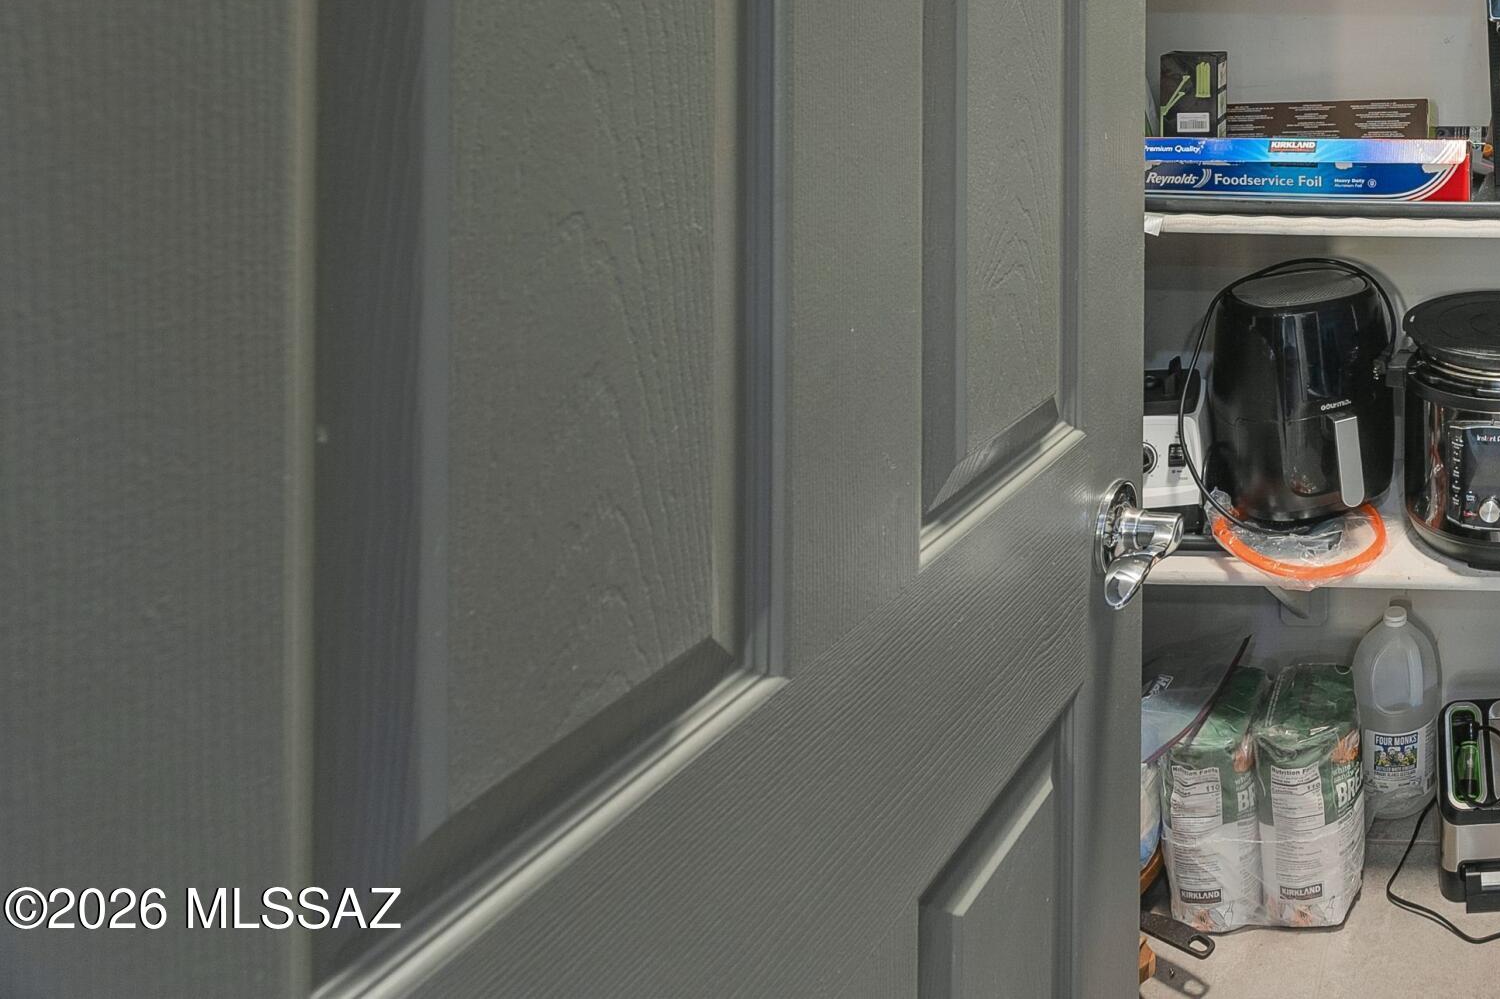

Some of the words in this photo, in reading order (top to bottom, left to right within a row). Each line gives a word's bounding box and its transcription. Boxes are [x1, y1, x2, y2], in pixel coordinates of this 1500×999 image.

[1174, 145, 1200, 154] Quality
[1271, 141, 1316, 149] KIRKLAND
[1146, 173, 1199, 187] Reynolds
[1214, 173, 1294, 187] Foodservice
[1298, 175, 1322, 187] Foil
[1375, 735, 1393, 746] FOUR
[1393, 734, 1417, 746] MONKS
[1271, 767, 1300, 776] Nutrition
[1180, 889, 1220, 900] KIRKLAND
[1281, 885, 1321, 896] KIRKLAND
